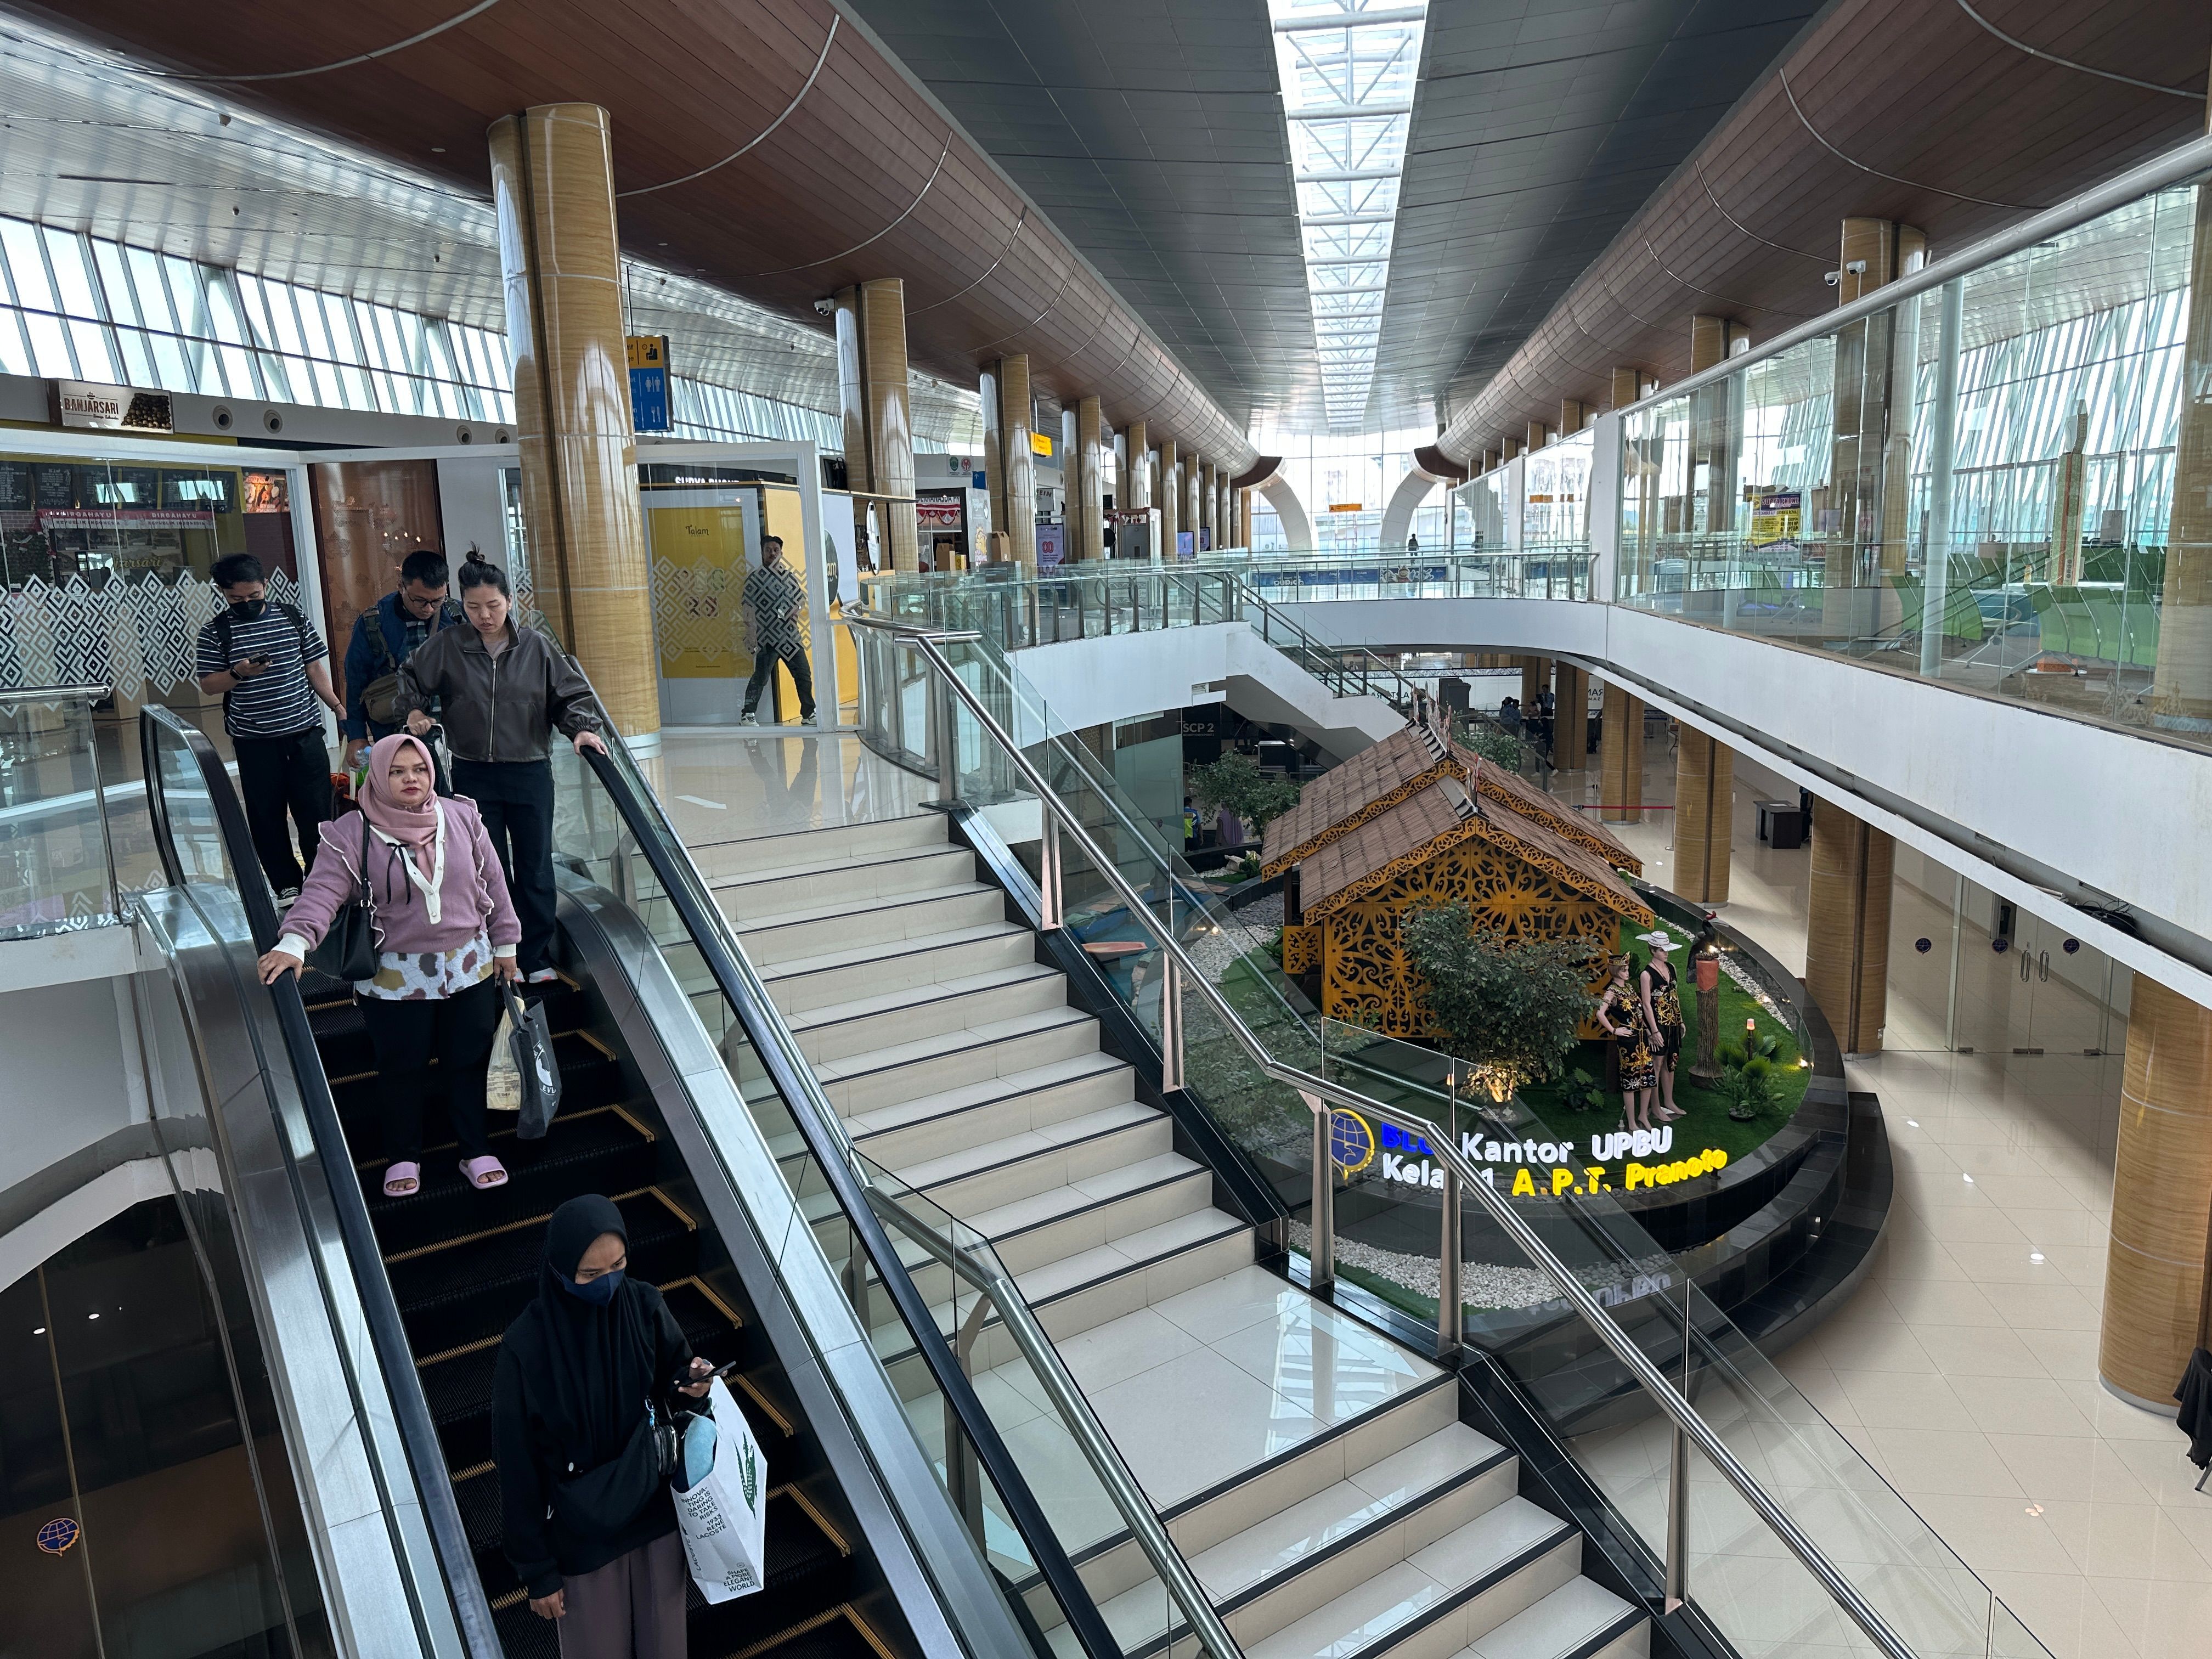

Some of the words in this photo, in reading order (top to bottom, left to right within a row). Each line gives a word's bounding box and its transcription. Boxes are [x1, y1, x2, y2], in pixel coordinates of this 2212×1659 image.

[64, 398, 119, 415] BANJARSARI
[686, 524, 709, 535] Talam
[1183, 723, 1205, 733] SCP
[1207, 723, 1215, 732] 2
[1462, 1132, 1574, 1164] Kantor
[1592, 1125, 1673, 1161] UPBU
[1383, 1153, 1463, 1190] Kela
[1511, 1166, 1612, 1197] A.P.T.
[1626, 1148, 1728, 1192] Pranoto
[687, 1496, 713, 1513] DARING
[688, 1496, 704, 1508] TING
[698, 1500, 716, 1514] TAKE
[699, 1505, 718, 1520] RISKS
[707, 1513, 722, 1525] 1933
[696, 1523, 727, 1540] LACOSTE
[724, 1576, 753, 1587] ELEGANT
[729, 1581, 755, 1592] WORLD
